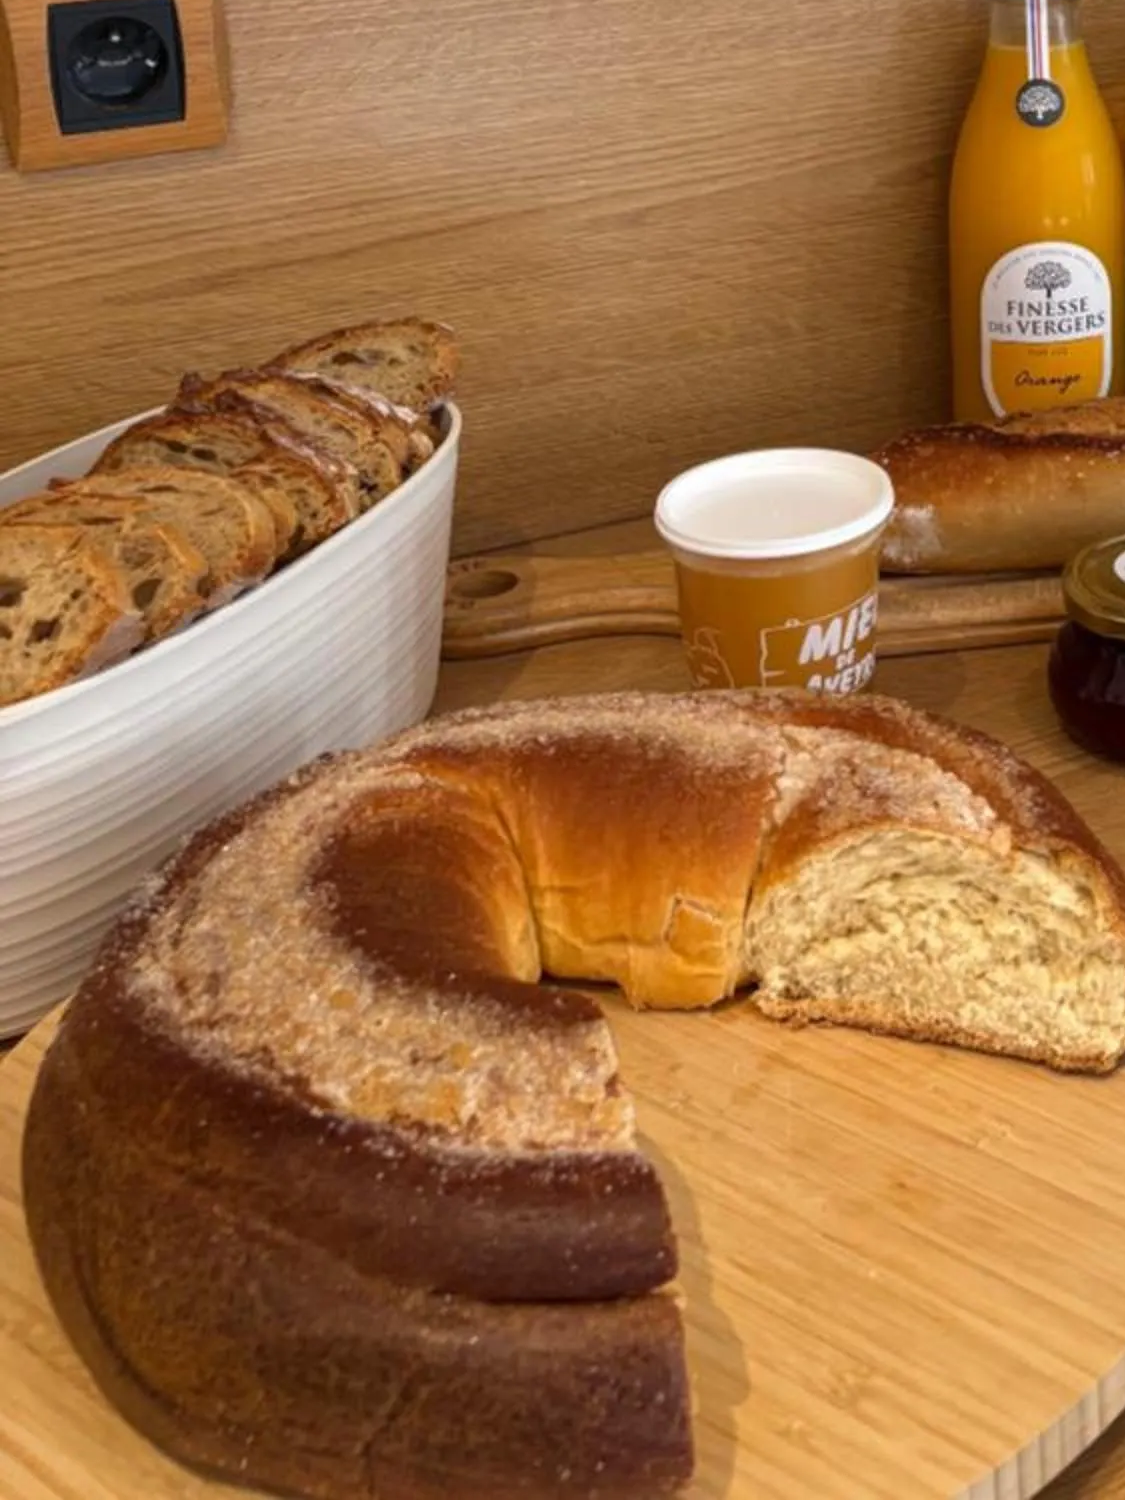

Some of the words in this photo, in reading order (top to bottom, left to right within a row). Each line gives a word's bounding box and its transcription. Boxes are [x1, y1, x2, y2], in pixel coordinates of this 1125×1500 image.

[1007, 296, 1089, 317] FINESSE
[989, 320, 1012, 334] DES
[1015, 310, 1105, 336] VERGERS
[1014, 369, 1081, 394] Orange
[799, 594, 878, 665] MIE
